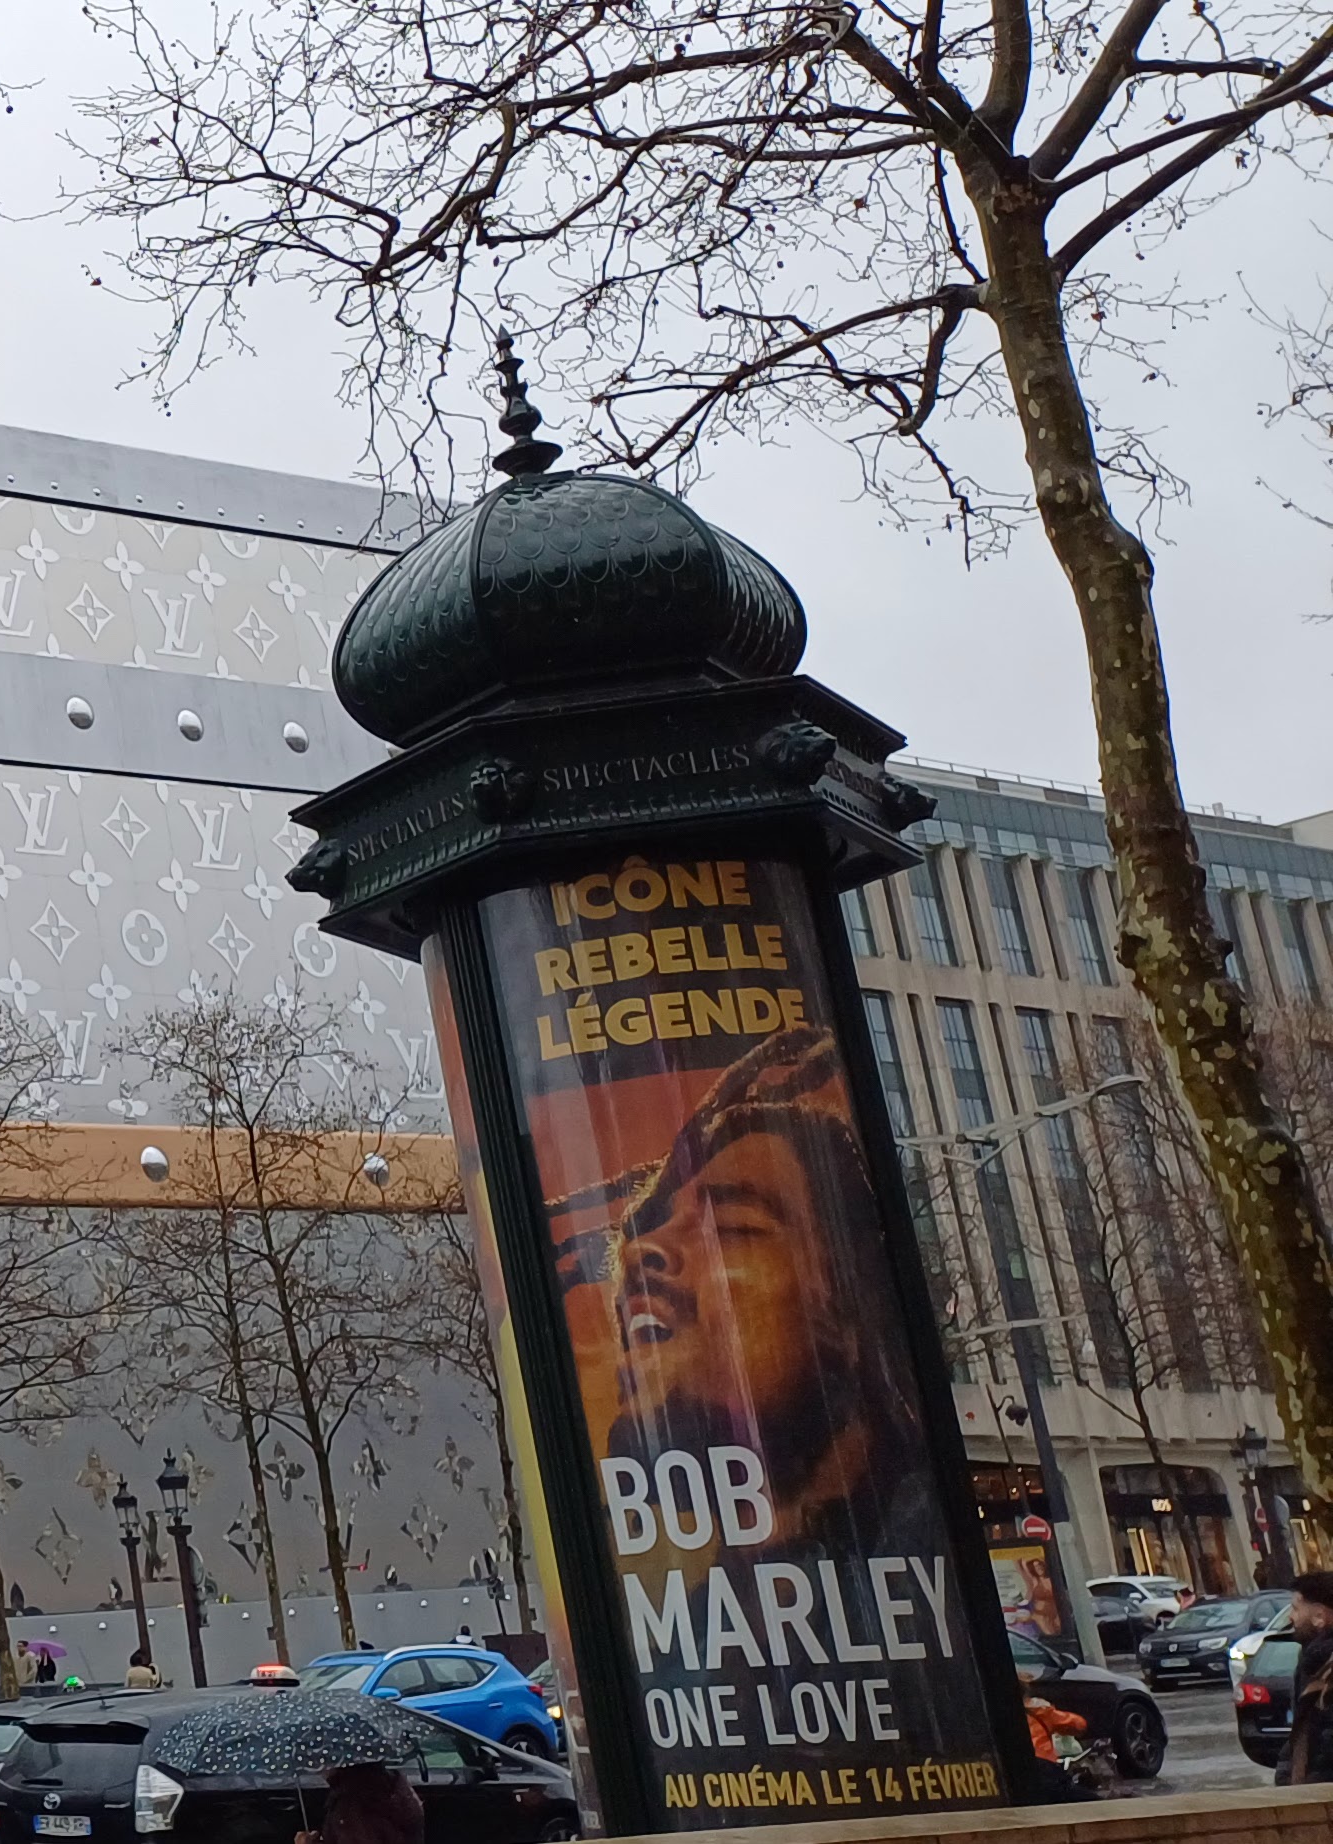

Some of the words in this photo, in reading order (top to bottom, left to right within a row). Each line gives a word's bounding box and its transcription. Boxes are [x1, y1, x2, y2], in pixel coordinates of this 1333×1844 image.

[143, 588, 203, 659] LV
[543, 743, 751, 793] SPECTACLES
[2, 781, 68, 856] LV
[179, 798, 242, 871] LV
[346, 791, 465, 867] SPECTACLES
[549, 855, 751, 927] ICÔNE
[534, 923, 788, 997] REBELLE
[536, 986, 809, 1061] LÉGENDE
[599, 1445, 774, 1556] BOB
[623, 1556, 954, 1674] MARLEY
[644, 1684, 746, 1749] ONE
[757, 1678, 900, 1746] LOVE
[665, 1774, 697, 1808] AU
[704, 1764, 817, 1808] CINÉMA
[821, 1769, 861, 1805] LE
[865, 1766, 903, 1802] 14
[906, 1757, 1000, 1801] FÉVRIER
